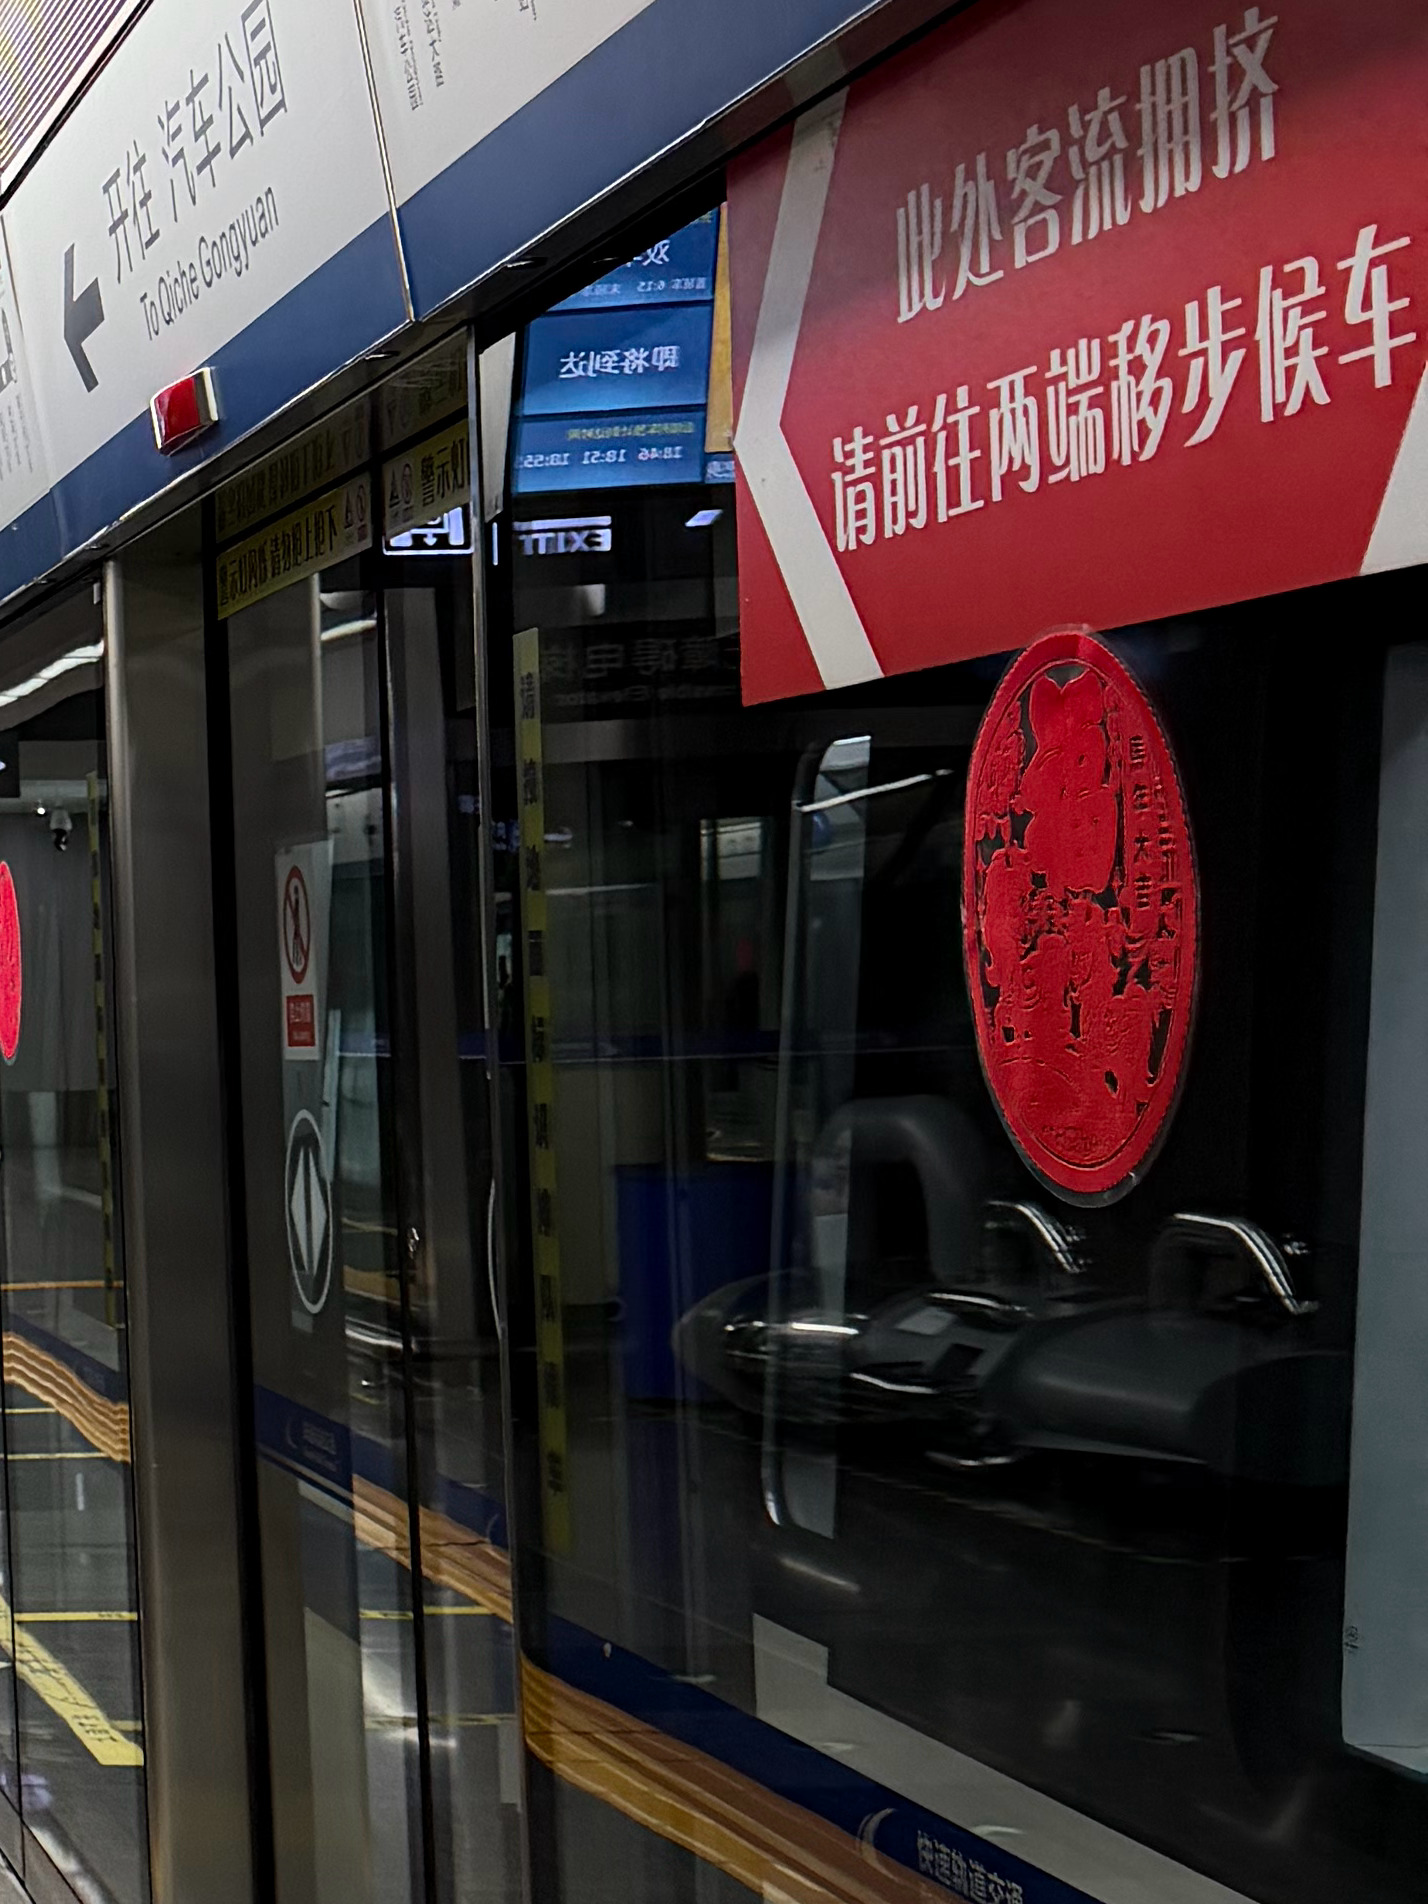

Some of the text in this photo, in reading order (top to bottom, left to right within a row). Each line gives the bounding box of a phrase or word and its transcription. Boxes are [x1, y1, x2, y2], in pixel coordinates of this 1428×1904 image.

[101, 139, 161, 283] 开往
[140, 185, 281, 341] To Qiche Gongyuan
[894, 6, 1280, 324] 此处客流拥挤
[830, 224, 1417, 553] 请前往两端移步候车
